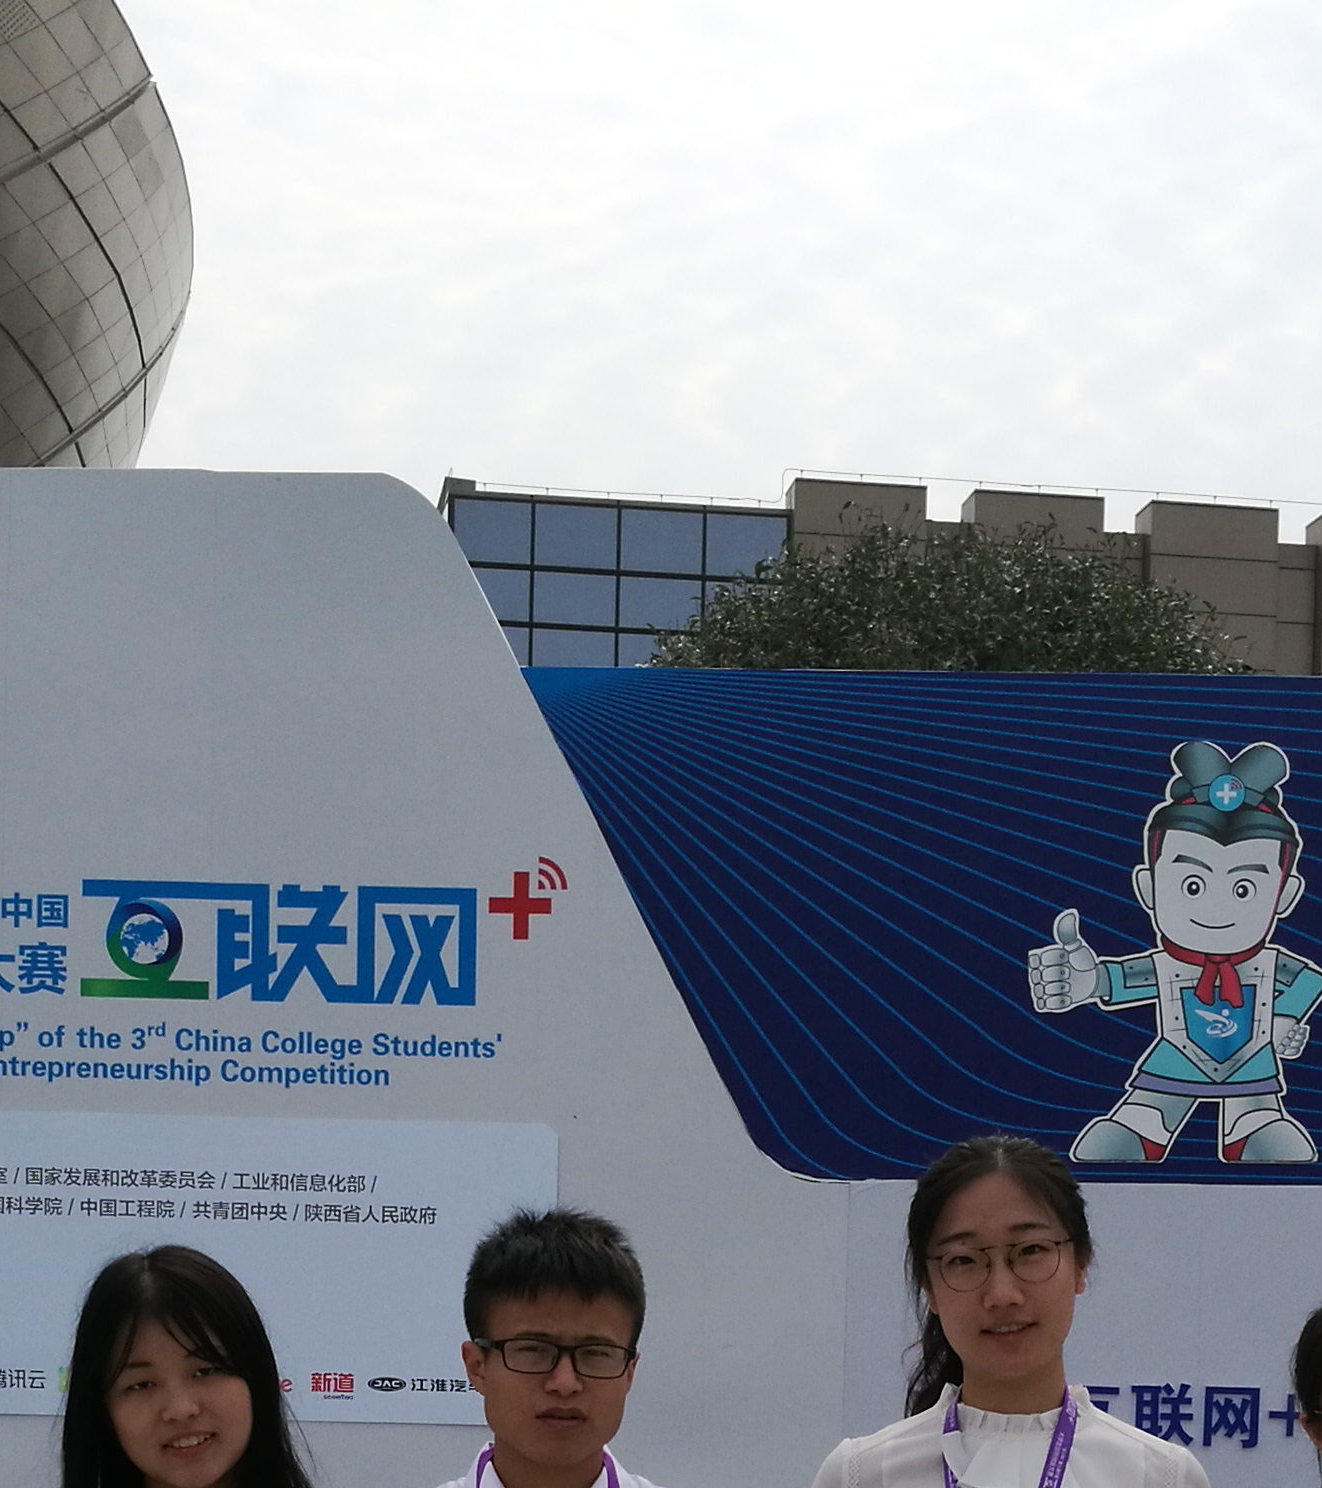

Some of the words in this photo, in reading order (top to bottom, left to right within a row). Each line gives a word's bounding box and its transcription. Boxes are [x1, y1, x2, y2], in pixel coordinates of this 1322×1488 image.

[37, 1024, 66, 1048] of
[76, 1025, 122, 1050] the
[130, 1020, 167, 1051] 3rd
[174, 1028, 253, 1054] China
[261, 1030, 363, 1062] College
[219, 1061, 390, 1089] Competition
[25, 1167, 216, 1191] 国家发展和改革委员会
[232, 1172, 366, 1194] 工业和信息化部
[80, 1198, 175, 1219] 中国工程院
[193, 1201, 288, 1222] 共青团中央
[304, 1203, 437, 1226] 陕西省人民政府
[311, 1372, 355, 1393] 新道
